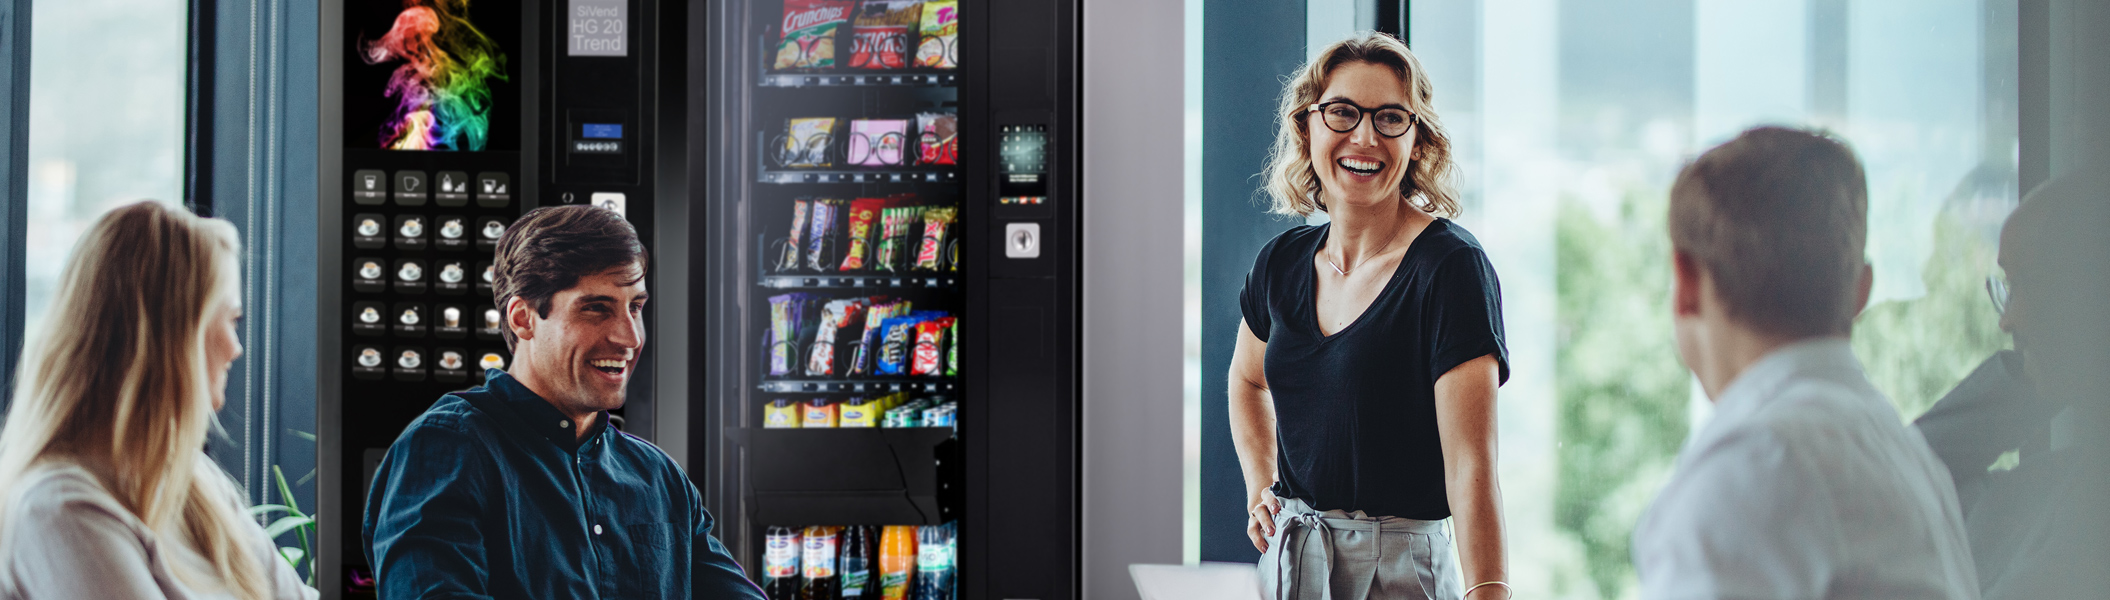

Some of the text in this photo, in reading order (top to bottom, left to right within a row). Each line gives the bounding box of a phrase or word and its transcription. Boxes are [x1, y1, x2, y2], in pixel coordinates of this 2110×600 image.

[577, 5, 618, 17] SiVend
[783, 6, 844, 33] Crunchips
[572, 19, 623, 34] HG 20
[573, 34, 621, 51] Trend
[849, 31, 907, 54] STICKS
